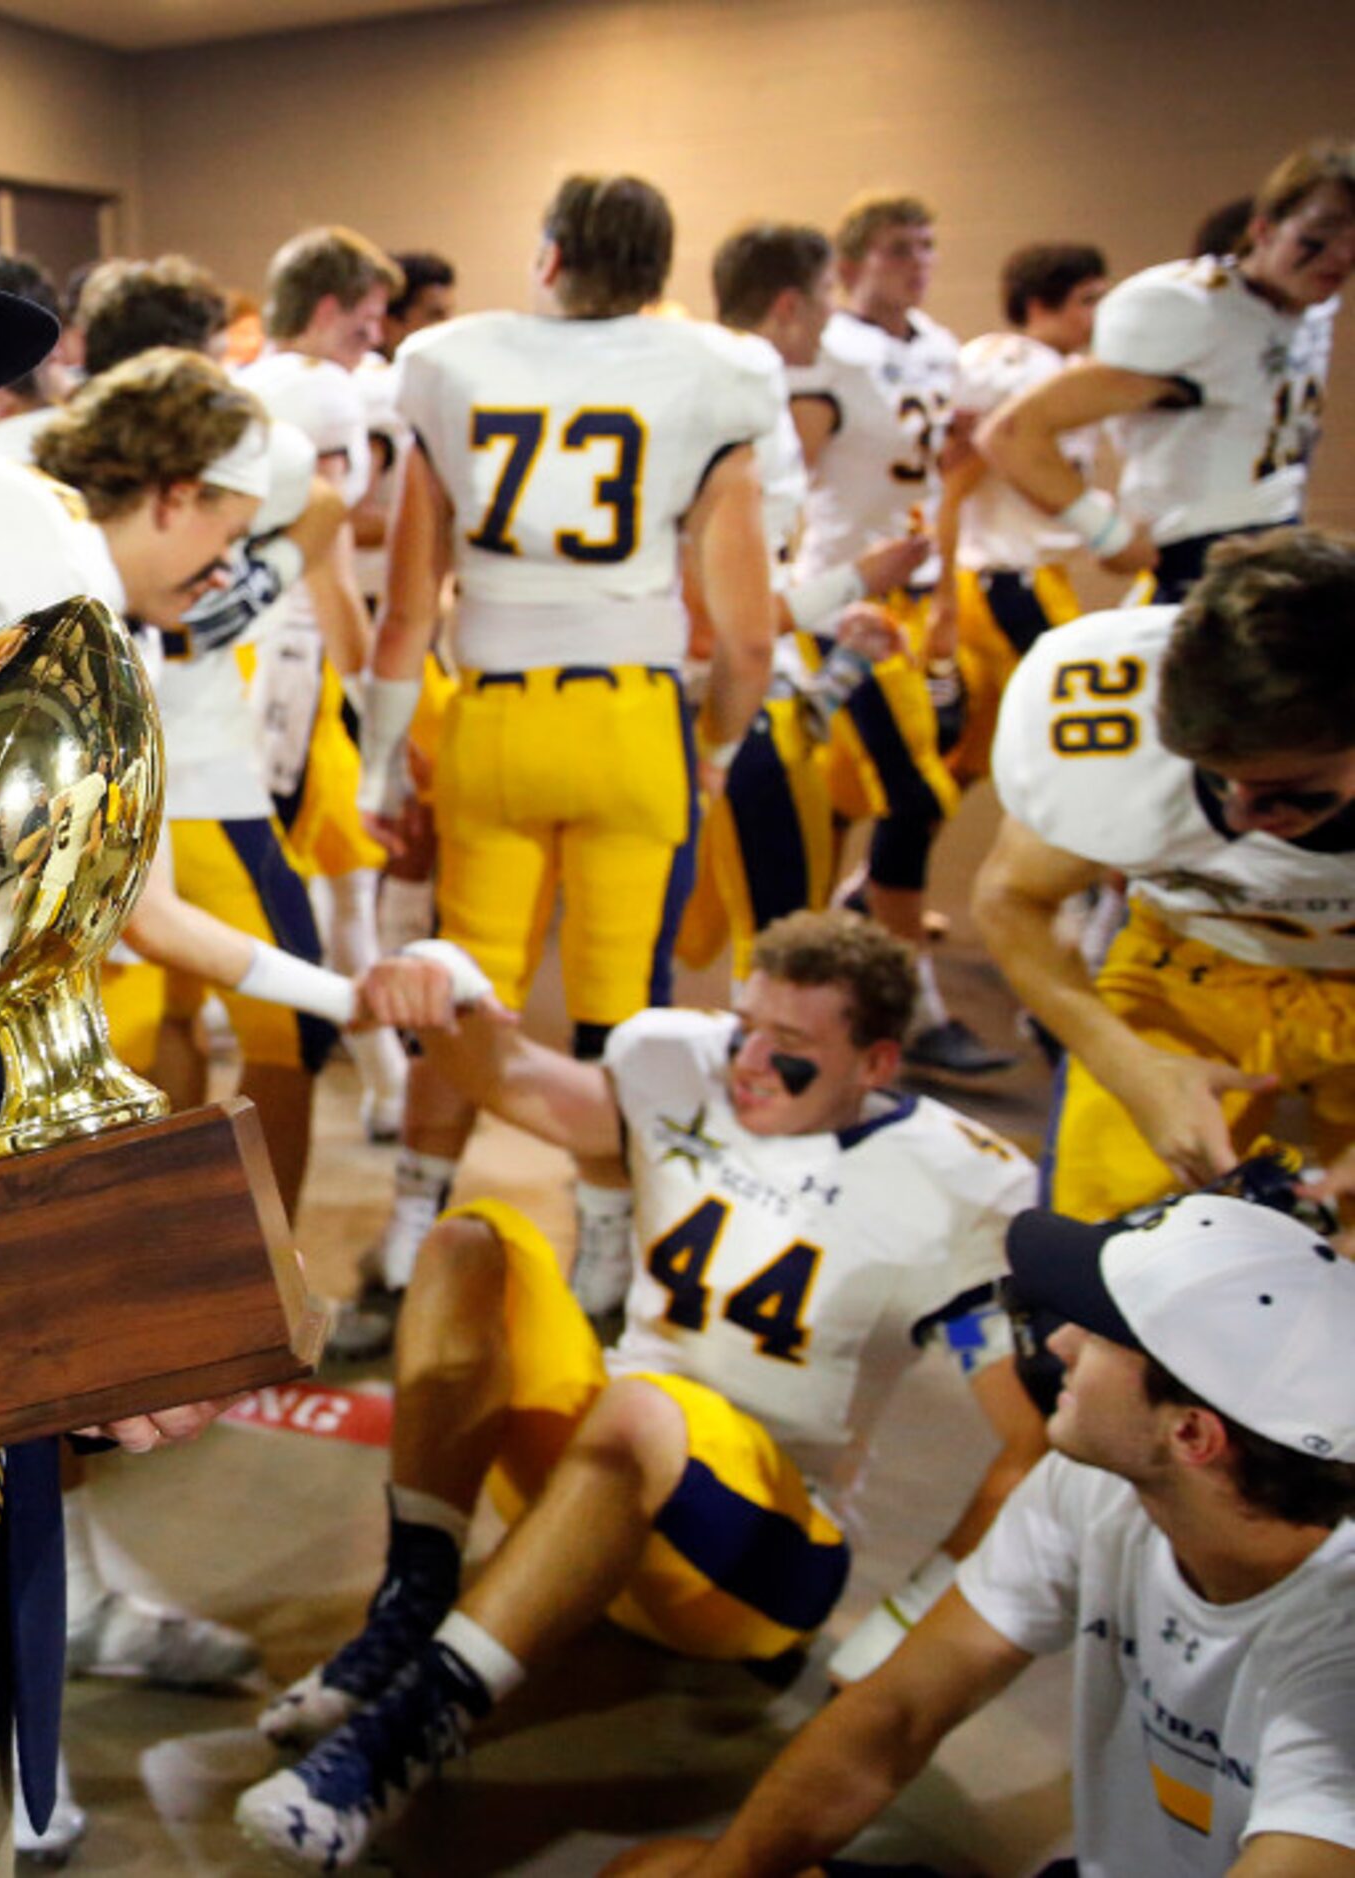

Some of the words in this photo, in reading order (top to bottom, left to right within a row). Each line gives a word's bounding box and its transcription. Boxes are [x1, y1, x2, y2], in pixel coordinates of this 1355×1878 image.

[466, 405, 649, 565] 73
[1050, 655, 1146, 757] 28
[644, 1195, 825, 1368] 44
